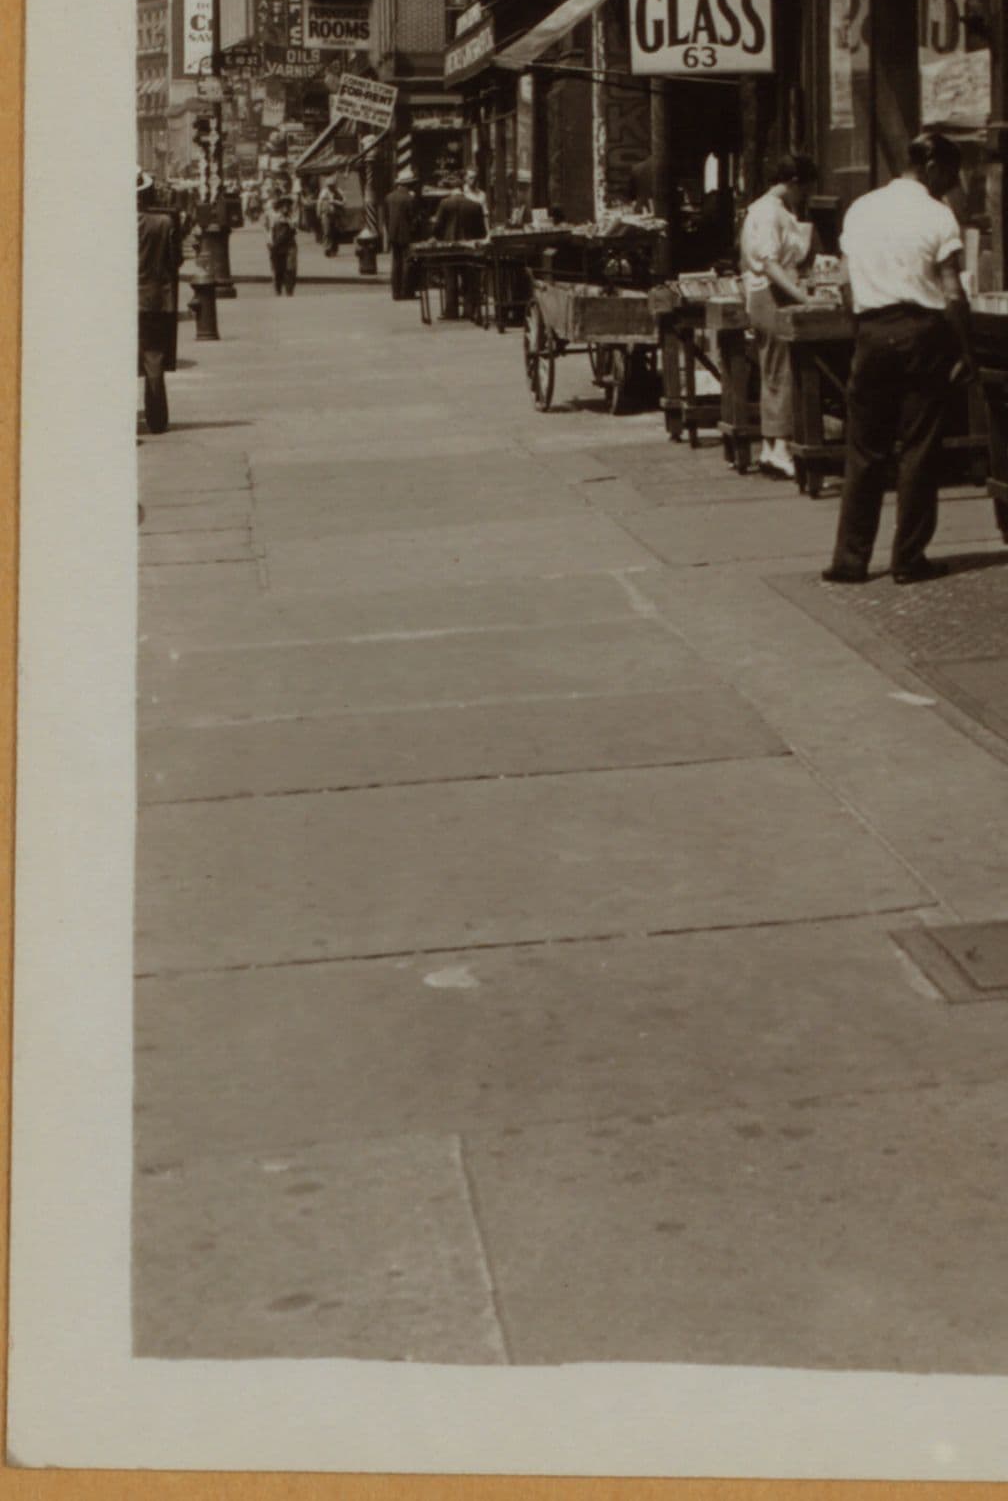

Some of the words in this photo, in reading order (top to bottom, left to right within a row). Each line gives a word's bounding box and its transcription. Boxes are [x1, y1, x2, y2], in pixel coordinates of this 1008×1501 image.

[308, 19, 370, 40] ROOMS
[286, 50, 320, 65] OILS
[681, 45, 719, 68] 63
